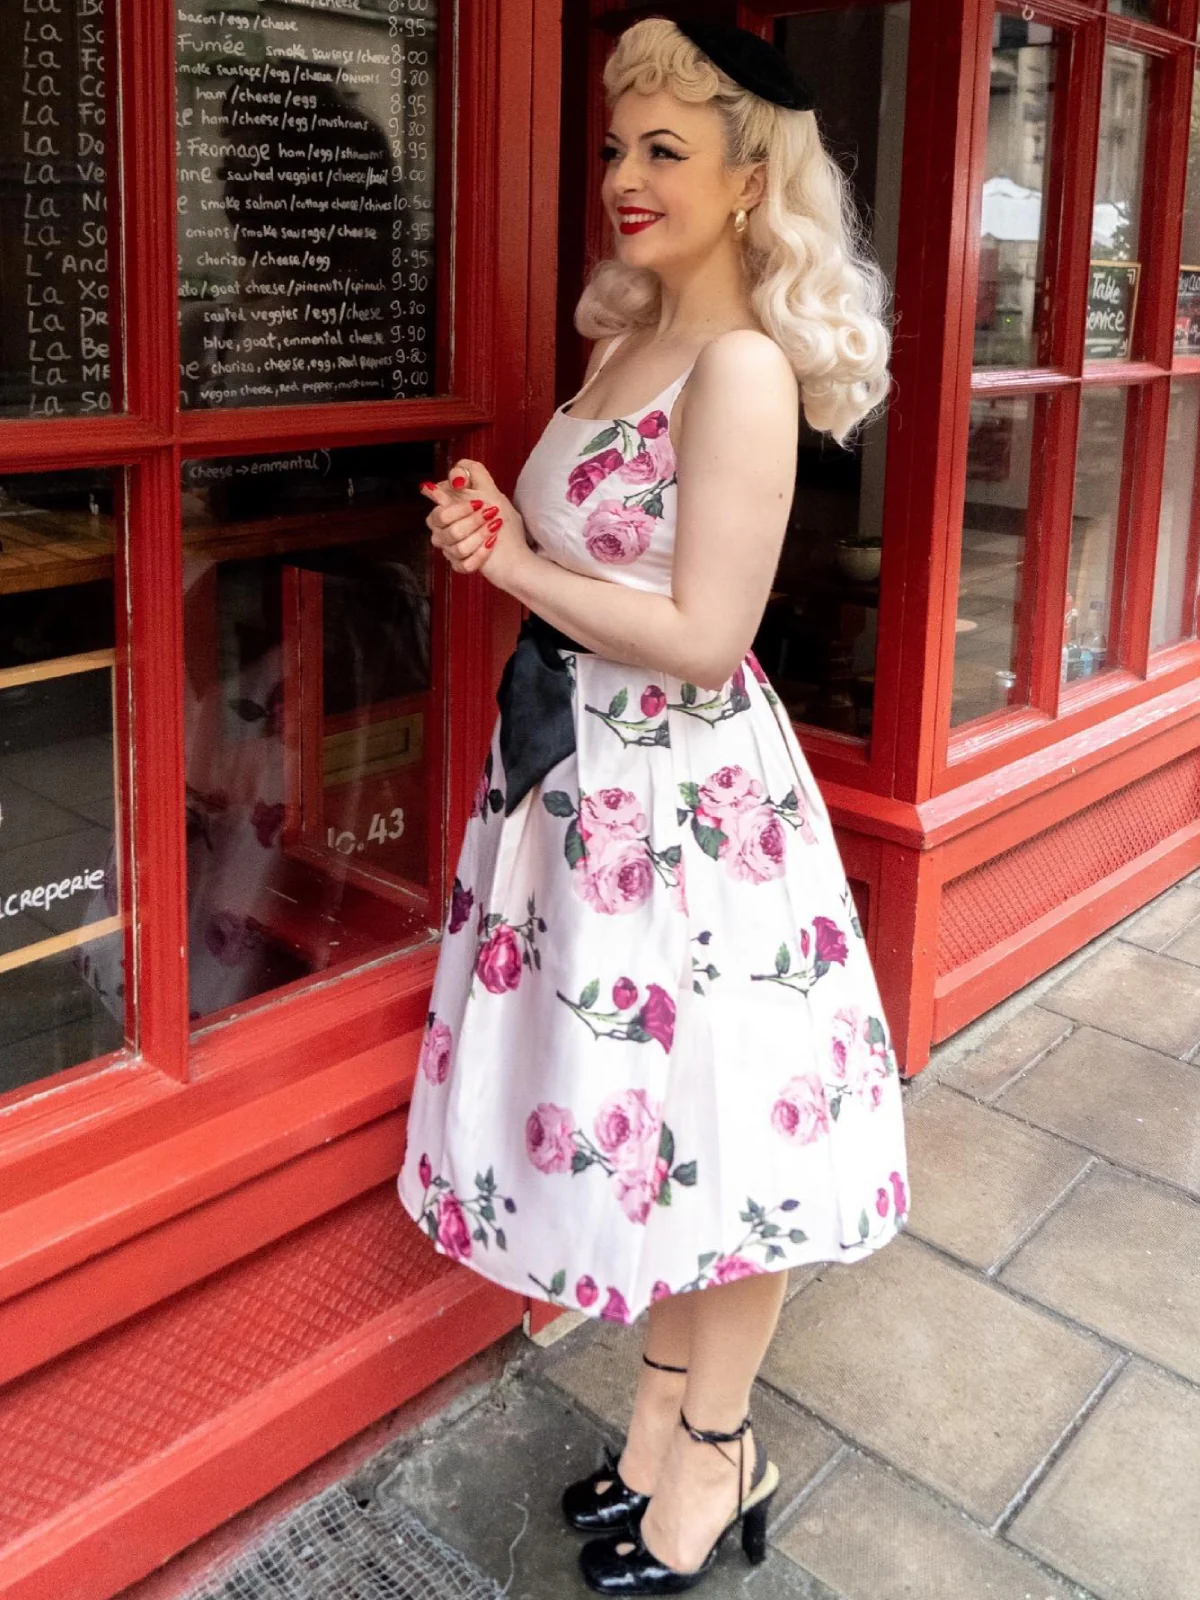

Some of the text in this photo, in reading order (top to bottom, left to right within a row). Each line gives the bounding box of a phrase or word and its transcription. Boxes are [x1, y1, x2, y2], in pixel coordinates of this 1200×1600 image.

[23, 20, 64, 43] La
[388, 15, 426, 37] 8.95
[21, 45, 62, 69] La
[391, 43, 428, 65] 8.00
[22, 71, 61, 96] La
[390, 67, 429, 87] 9.80
[21, 100, 60, 126] La
[390, 93, 427, 118] 8.95
[388, 117, 426, 138] 9.80
[23, 131, 60, 157] La
[391, 139, 428, 160] 8.95
[23, 161, 61, 185] La
[391, 165, 427, 183] 9.00
[24, 192, 61, 219] La
[393, 194, 433, 211] 10.50
[24, 222, 61, 247] La
[391, 219, 432, 242] 8.95
[391, 247, 430, 270] 8.95
[391, 271, 429, 292] 9.90
[1092, 272, 1121, 304] Table
[26, 283, 65, 307] La
[28, 310, 65, 334] La
[389, 325, 426, 343] 9.90
[29, 339, 72, 362] La
[30, 364, 68, 386] La
[391, 369, 429, 391] 9.00
[366, 807, 405, 845] 43
